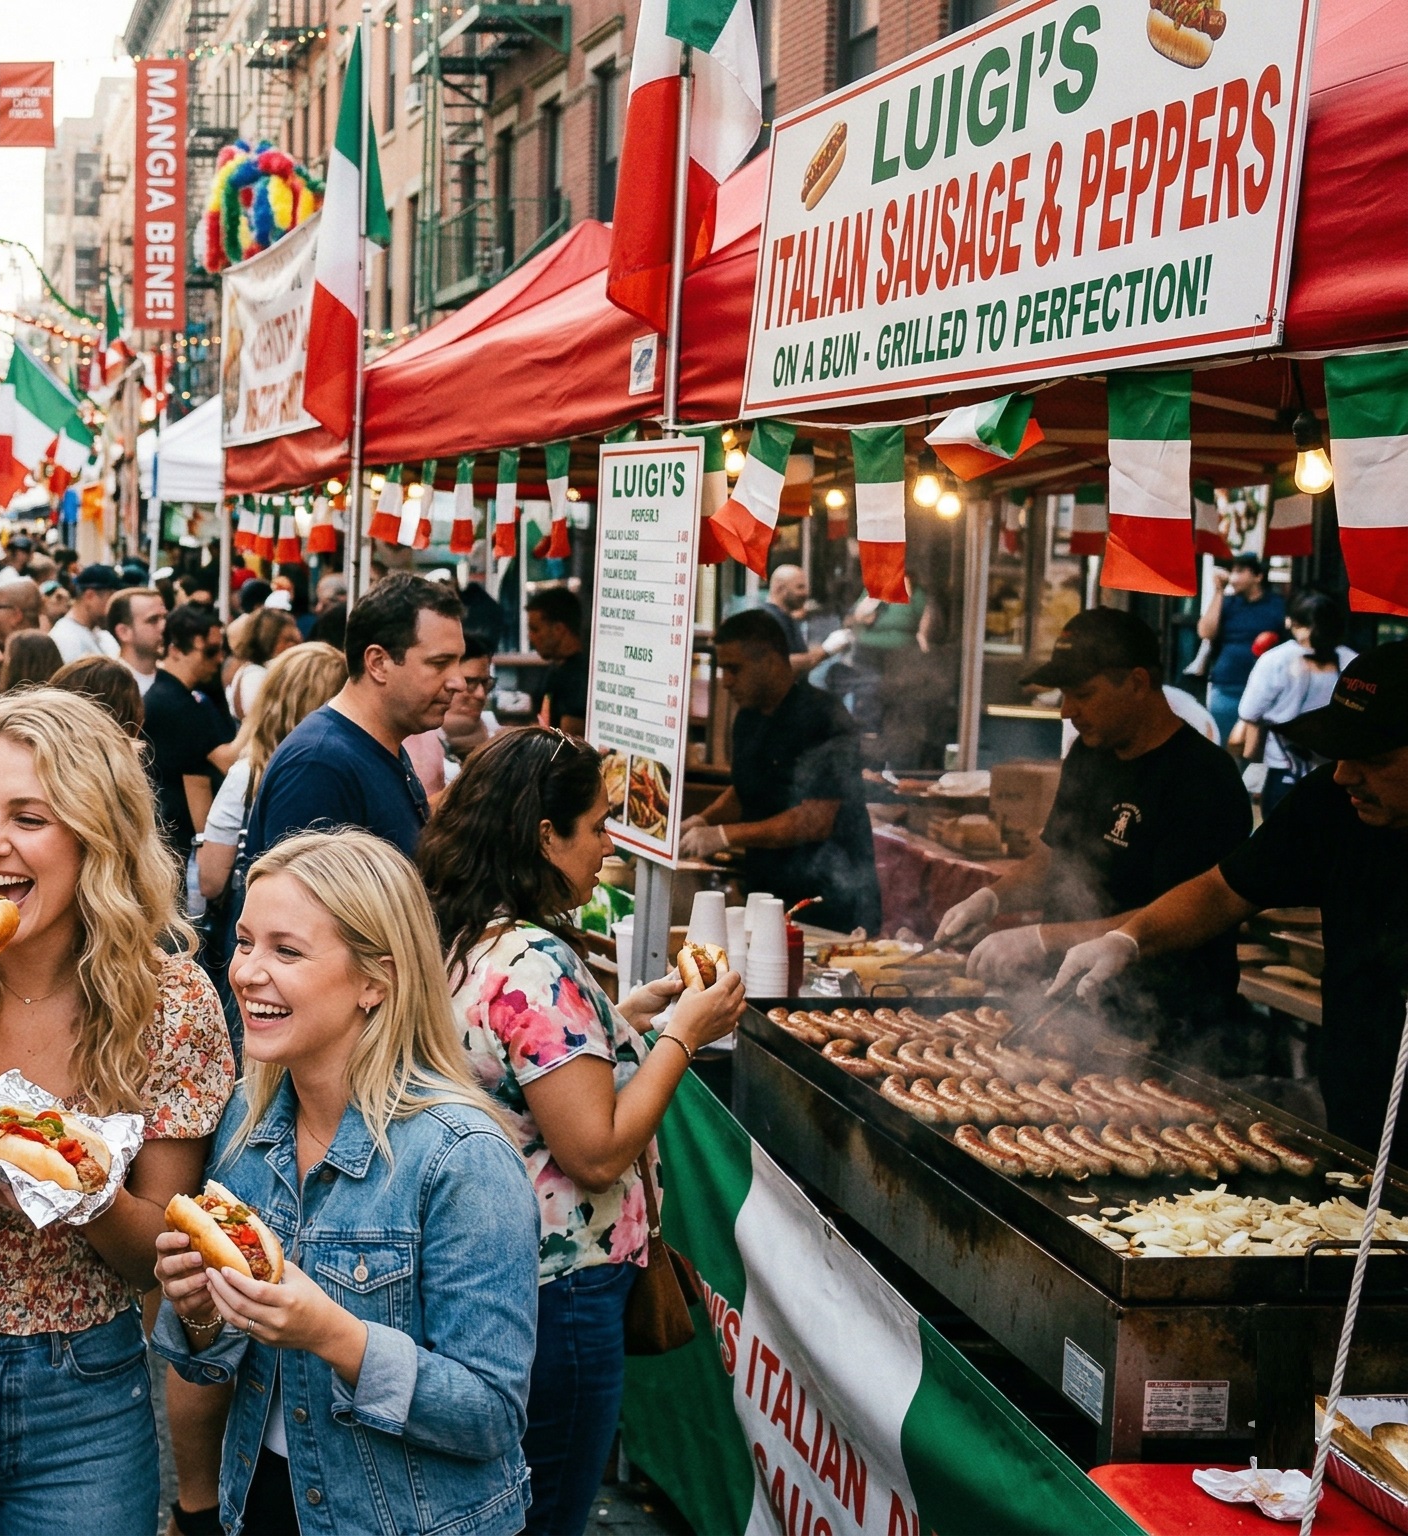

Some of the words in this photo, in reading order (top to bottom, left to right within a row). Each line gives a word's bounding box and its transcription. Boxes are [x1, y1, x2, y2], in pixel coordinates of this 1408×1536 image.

[145, 68, 178, 213] MANGIA
[871, 4, 1101, 186] LUIGI'S
[764, 208, 873, 330] ITALIAN
[876, 152, 1031, 305] SAUSAGE
[1034, 141, 1063, 267] &
[1073, 64, 1281, 258] PEPPERS
[145, 221, 176, 320] BENE!
[773, 343, 800, 388] ON
[801, 341, 814, 384] A
[819, 331, 861, 381] BUN
[876, 308, 968, 371] GRILLED
[976, 299, 1007, 354] TO
[1013, 253, 1213, 348] PERFECTION!
[612, 461, 686, 499] LUIGI'S
[745, 1334, 867, 1529] ITALIAN
[753, 1440, 833, 1536] SAU
